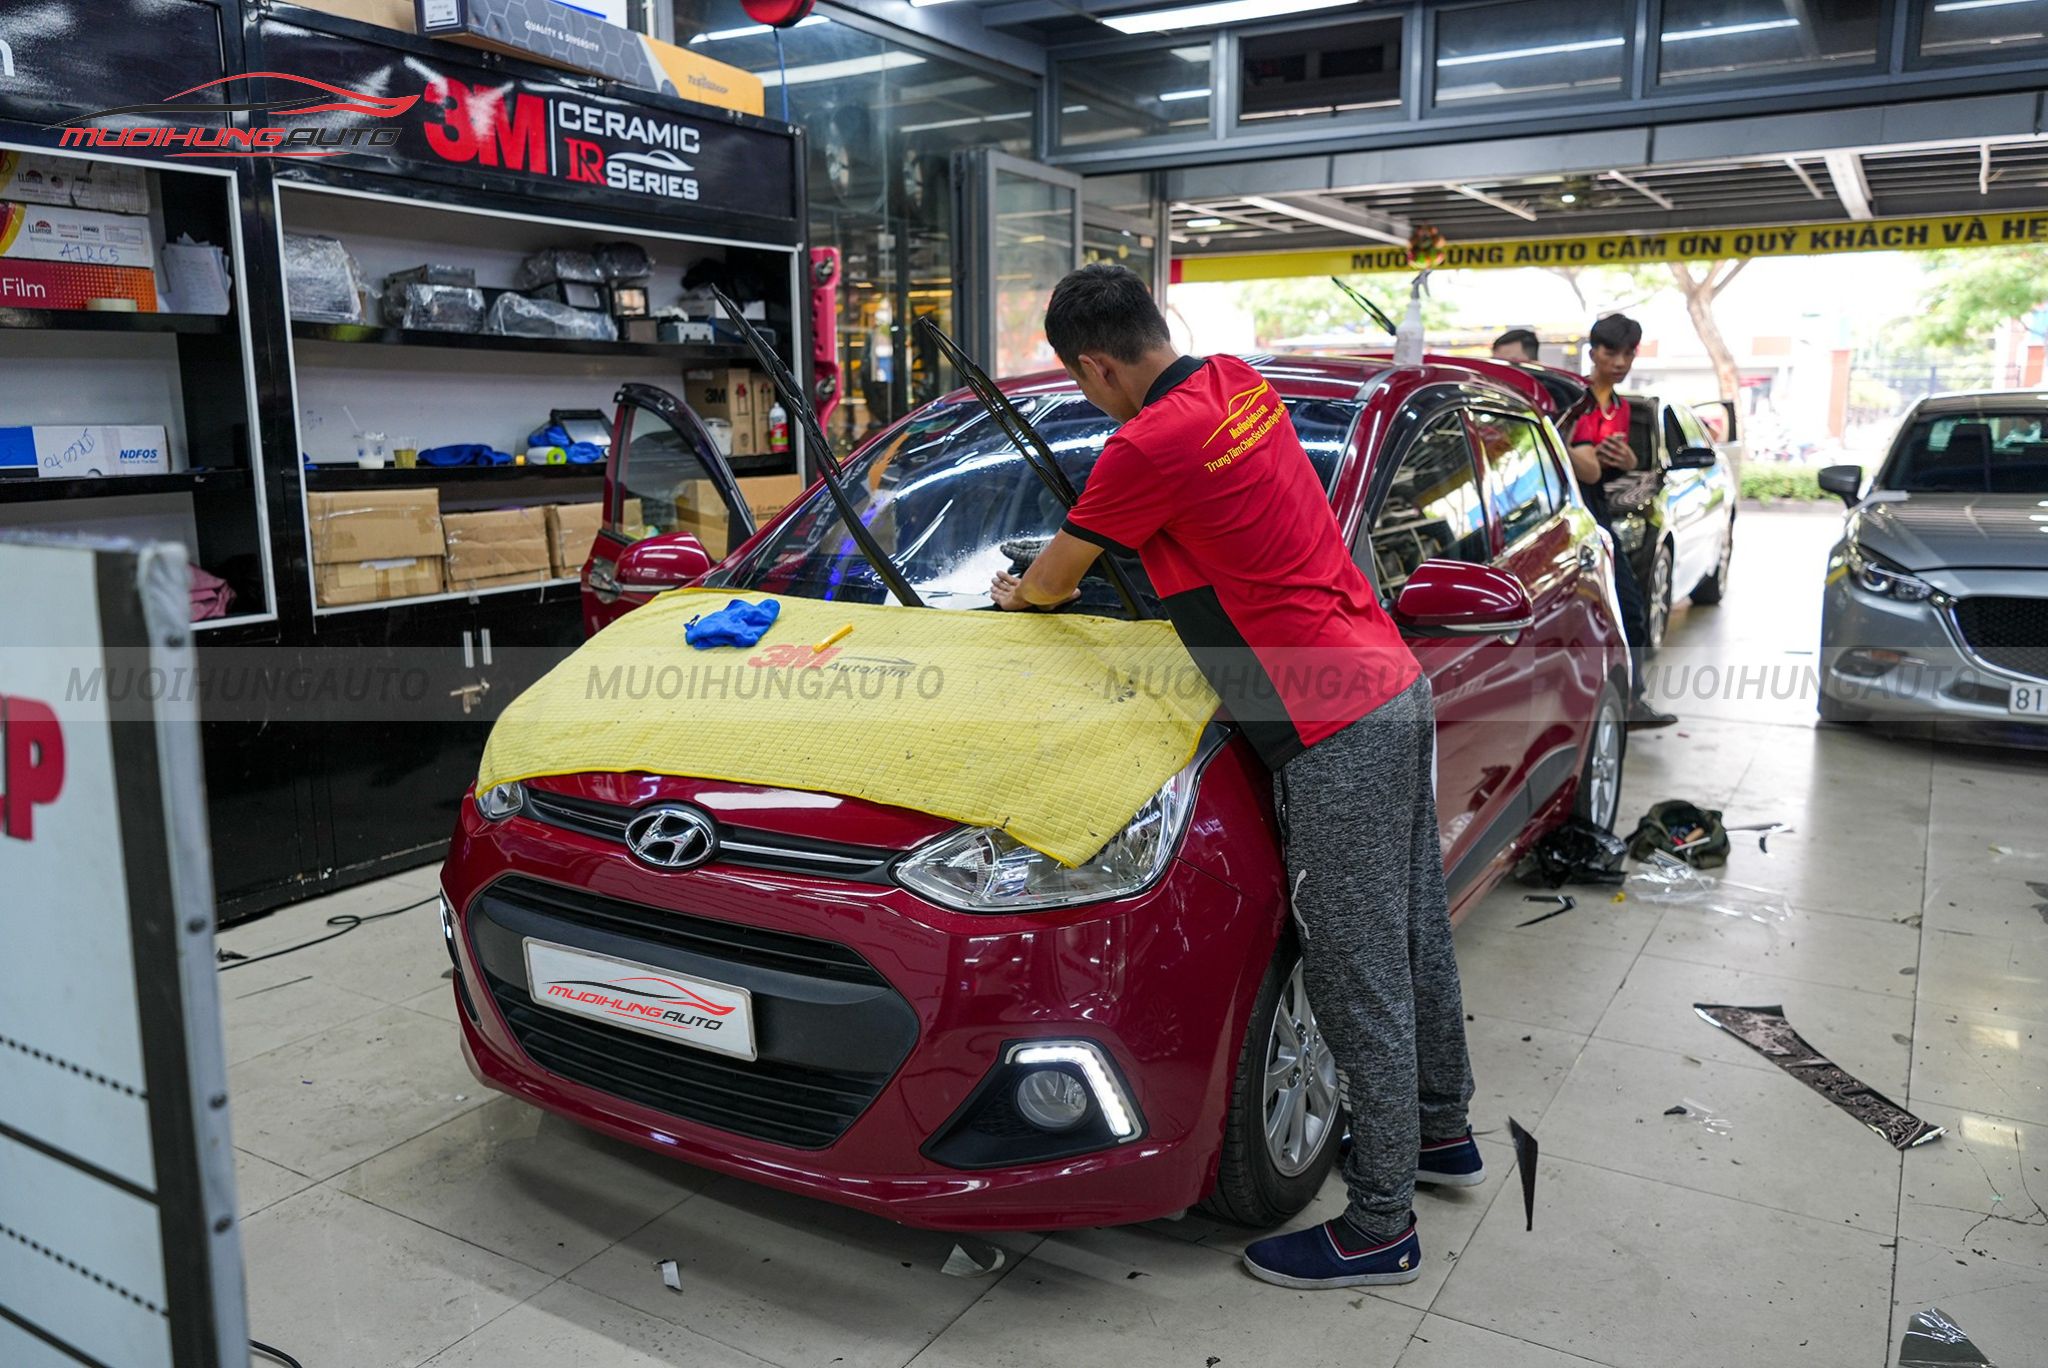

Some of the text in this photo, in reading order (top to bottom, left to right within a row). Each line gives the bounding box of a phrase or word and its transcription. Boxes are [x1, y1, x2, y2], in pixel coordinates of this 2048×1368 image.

[424, 76, 548, 174] 3M
[558, 101, 700, 154] CERAMIC
[605, 161, 699, 200] SERIES
[1352, 248, 1409, 270] MƯỜ
[1439, 245, 1504, 267] ÙNG
[1514, 241, 1587, 262] AUTO
[1597, 235, 1667, 259] CẢM
[1678, 235, 1722, 256] ƠN
[1733, 228, 1798, 254] QUÝ
[1809, 223, 1929, 249] KHÁCH
[1942, 217, 1988, 243] VÀ
[120, 449, 158, 459] NDFOS
[1204, 454, 1232, 473] Trung
[2016, 688, 2042, 711] 81
[548, 985, 723, 1031] MUOIHUNGAUTO
